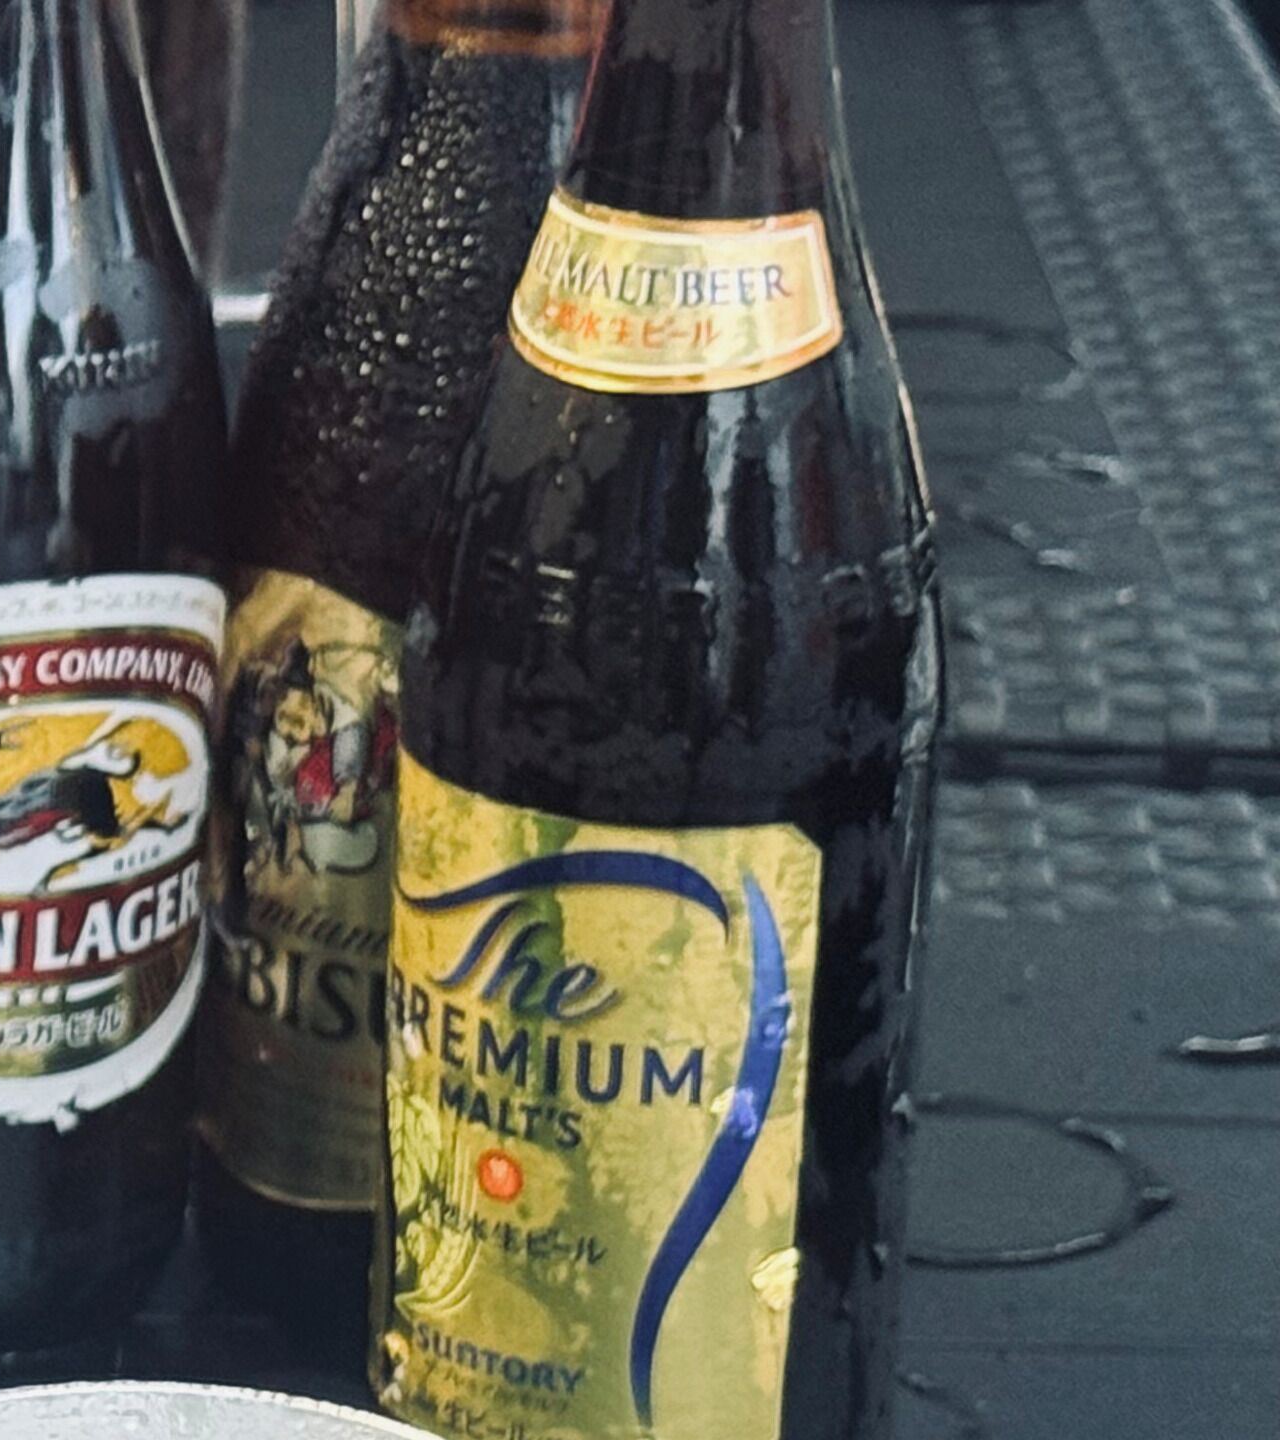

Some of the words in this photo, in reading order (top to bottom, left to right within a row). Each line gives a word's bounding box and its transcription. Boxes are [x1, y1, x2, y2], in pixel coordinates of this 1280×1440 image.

[676, 263, 792, 309] BEER
[32, 861, 202, 973] LAGER
[439, 1076, 584, 1150] MALT'S
